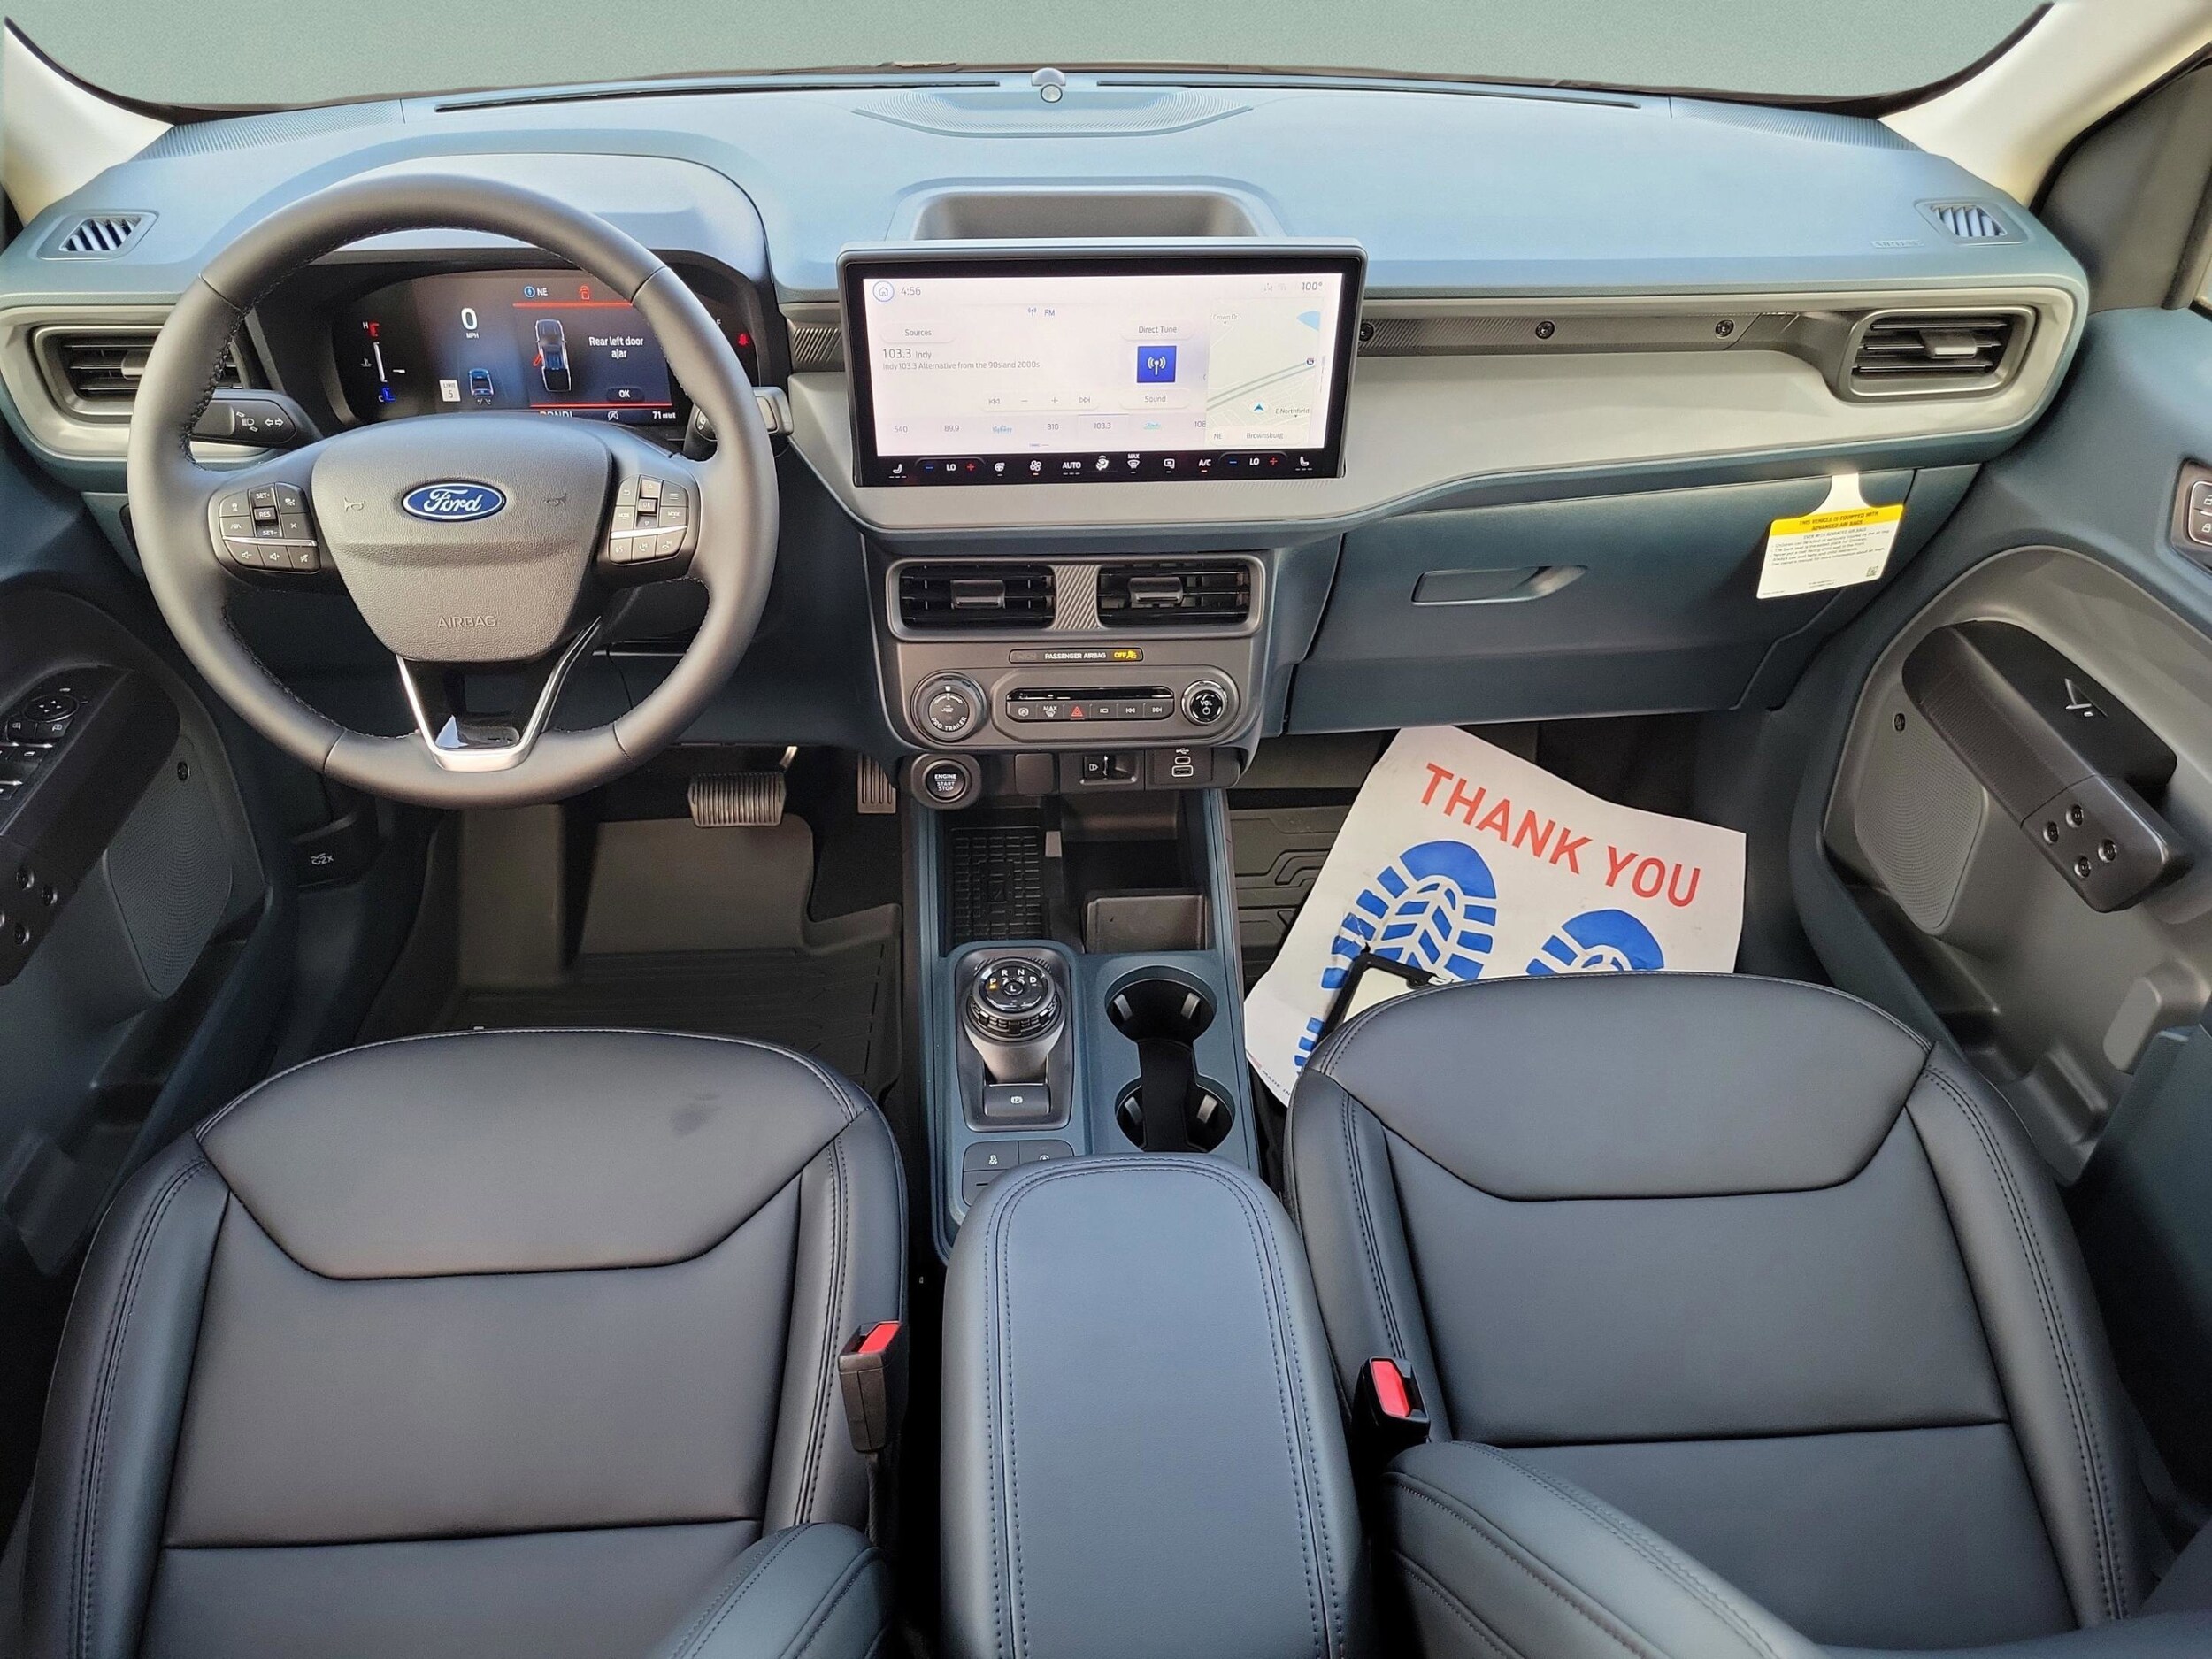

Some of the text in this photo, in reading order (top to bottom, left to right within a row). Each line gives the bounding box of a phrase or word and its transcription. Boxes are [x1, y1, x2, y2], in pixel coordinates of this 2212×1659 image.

[536, 288, 549, 296] NE
[901, 287, 921, 296] 4:56
[1044, 308, 1056, 317] FM
[461, 307, 478, 330] 0
[904, 328, 933, 337] Sources
[1159, 325, 1178, 334] Tune
[588, 335, 644, 347] Rear left door
[611, 349, 627, 360] ajar
[882, 348, 932, 359] 103.3 Indy
[882, 362, 897, 371] Indy
[918, 361, 956, 370] Alternative
[975, 360, 987, 369] the
[988, 360, 1002, 369] 90s
[1002, 360, 1016, 369] and
[1017, 360, 1041, 369] 2000s
[448, 389, 454, 399] 5
[618, 389, 631, 398] OK
[652, 411, 662, 419] 71
[1062, 461, 1081, 470] AUTO
[1198, 458, 1212, 467] A/C
[946, 463, 956, 472] LO
[423, 488, 483, 512] Ford
[437, 615, 497, 629] AIRBAG
[931, 716, 967, 732] PRO TRAILER
[1419, 762, 1701, 909] THANK YOU
